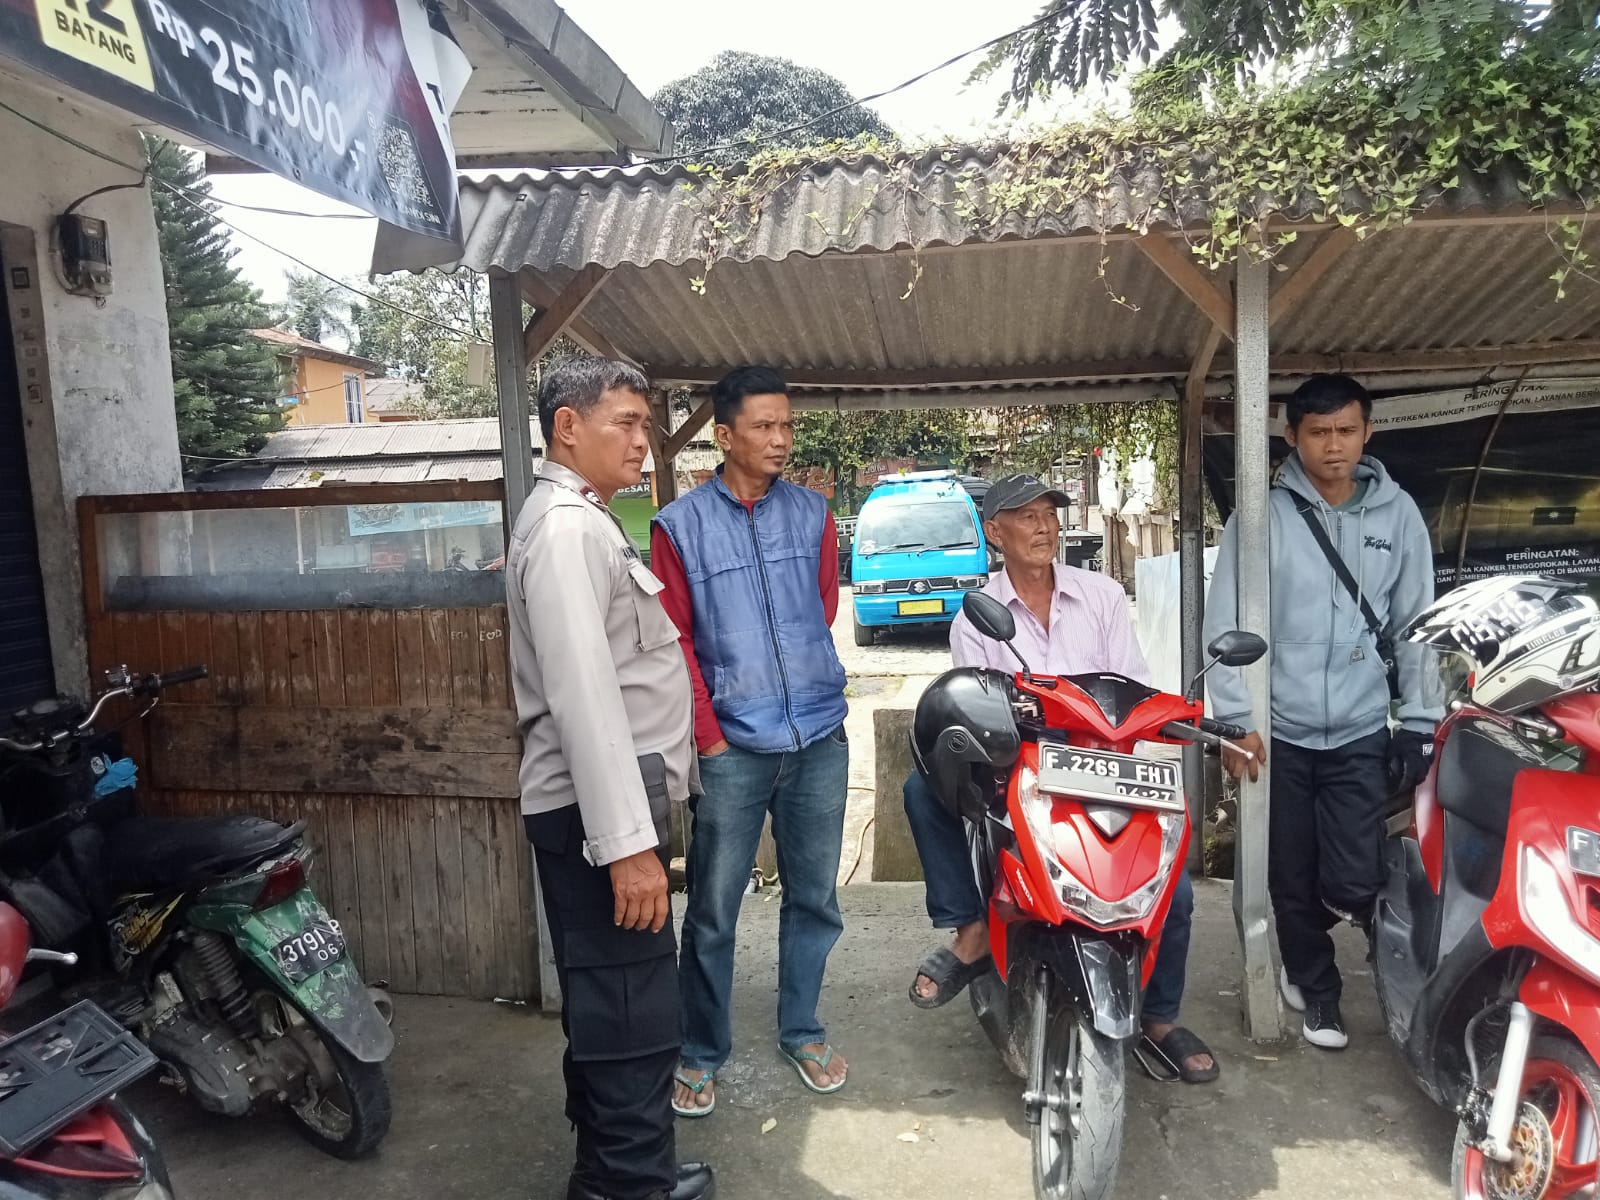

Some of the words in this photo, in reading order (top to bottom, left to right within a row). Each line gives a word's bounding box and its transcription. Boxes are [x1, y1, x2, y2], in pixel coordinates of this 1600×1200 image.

[54, 9, 136, 65] BATANG
[150, 0, 195, 57] Rp
[1391, 412, 1430, 423] TERKENA
[1431, 406, 1465, 418] KANKER
[1506, 548, 1579, 561] PERINGATAN:
[1437, 576, 1452, 584] DAN
[1557, 567, 1566, 575] DI
[1567, 565, 1597, 574] BAWAH
[1438, 567, 1472, 576] TERKNA
[1473, 563, 1506, 573] KANKER
[1573, 831, 1590, 850] F
[283, 928, 326, 962] 3791
